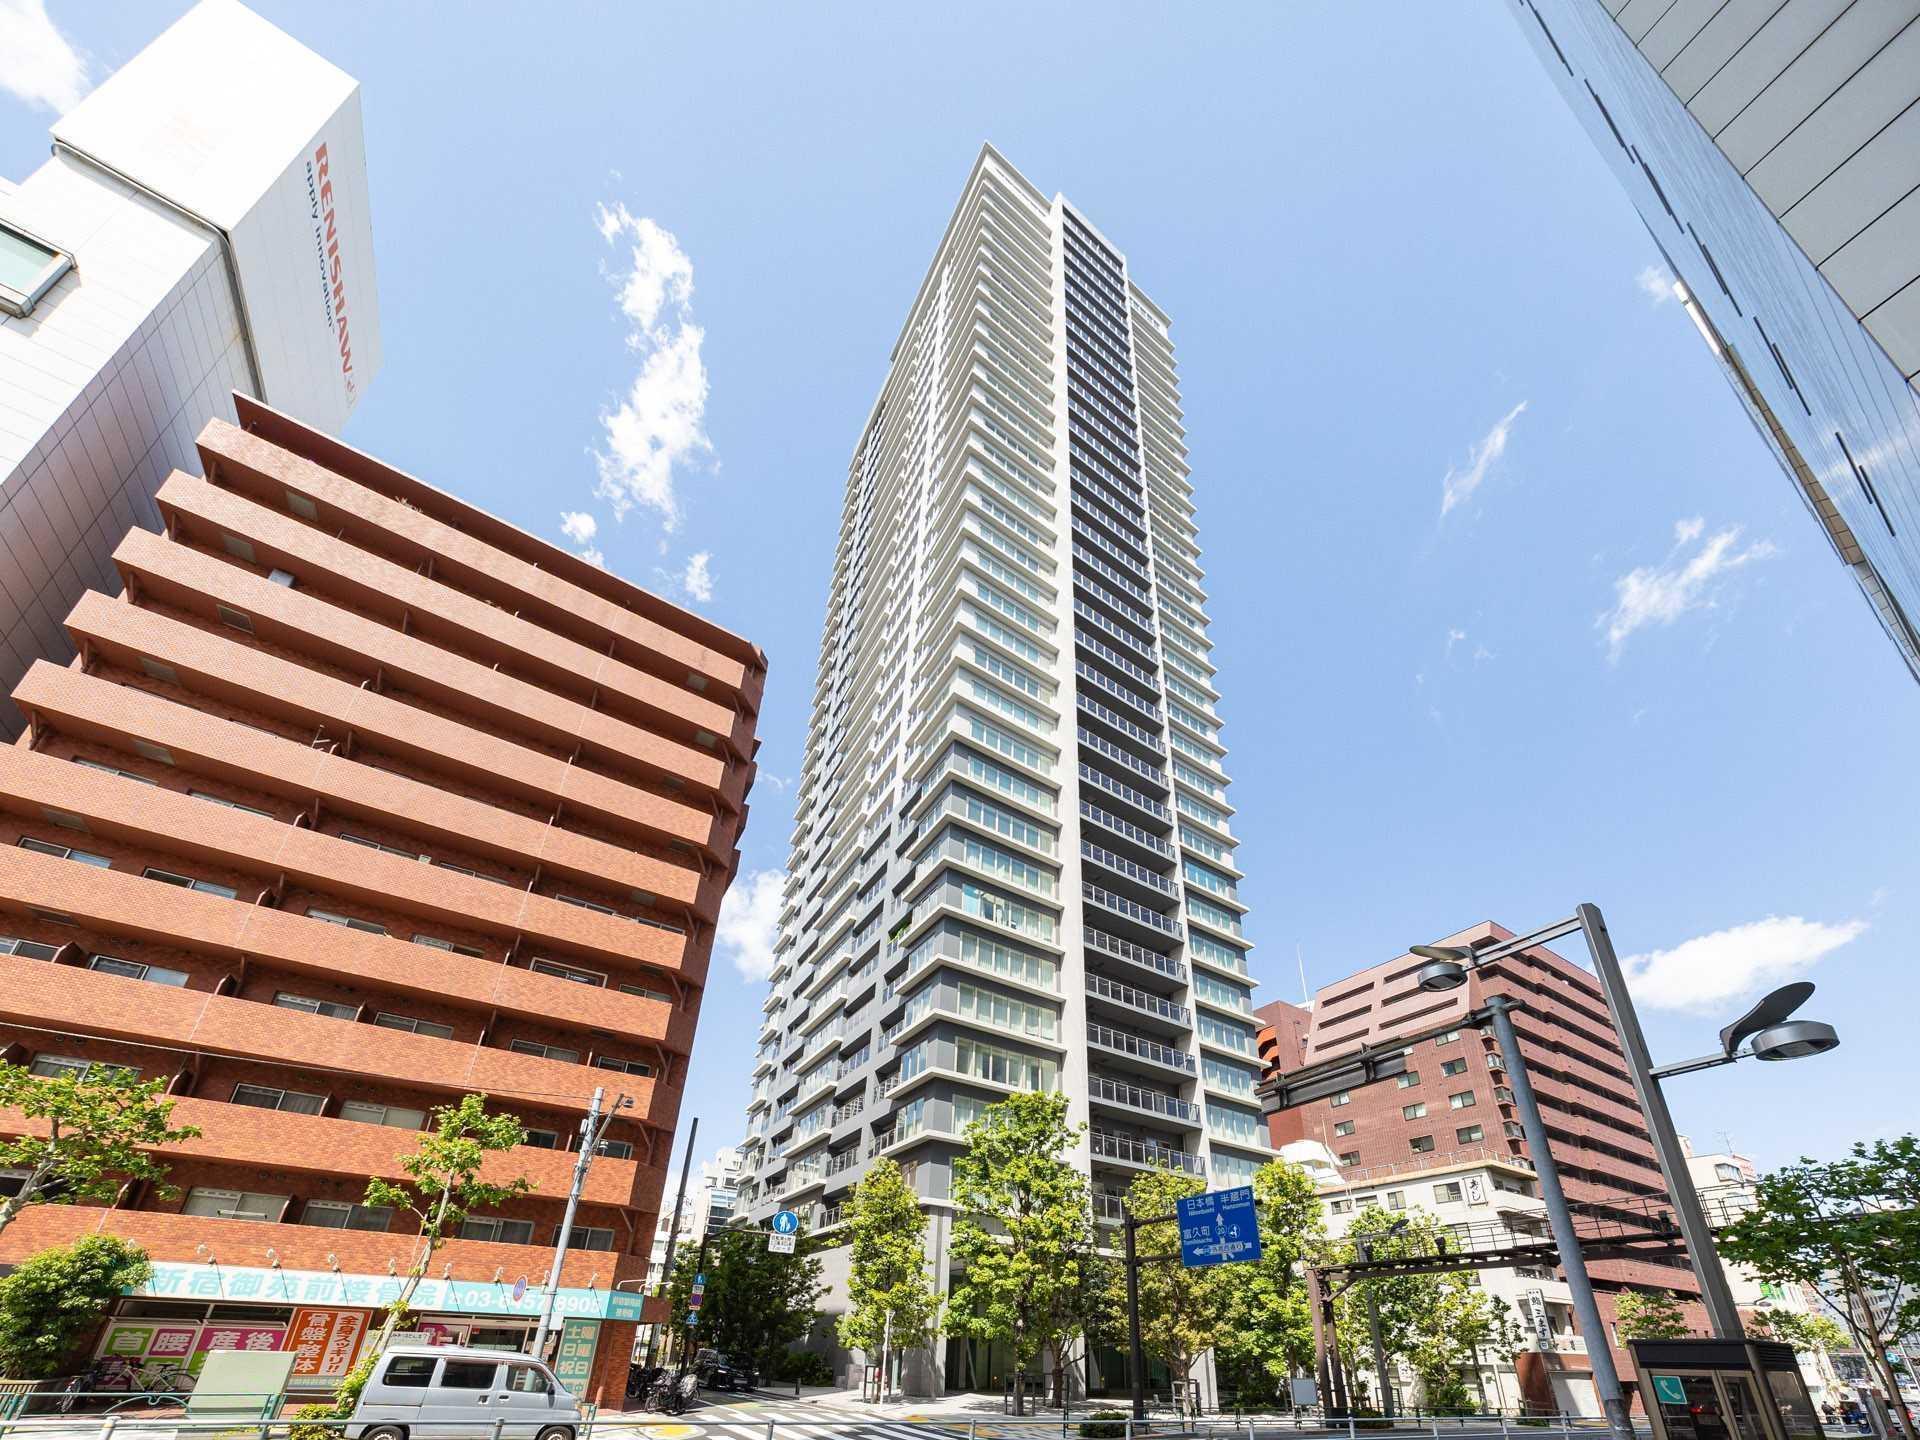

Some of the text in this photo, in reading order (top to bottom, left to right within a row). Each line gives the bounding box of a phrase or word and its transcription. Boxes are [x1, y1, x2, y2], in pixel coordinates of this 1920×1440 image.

[306, 161, 319, 220] apply
[315, 142, 352, 373] RENISHAW
[112, 1331, 193, 1352] 首 腰
[207, 1331, 275, 1351] 産後
